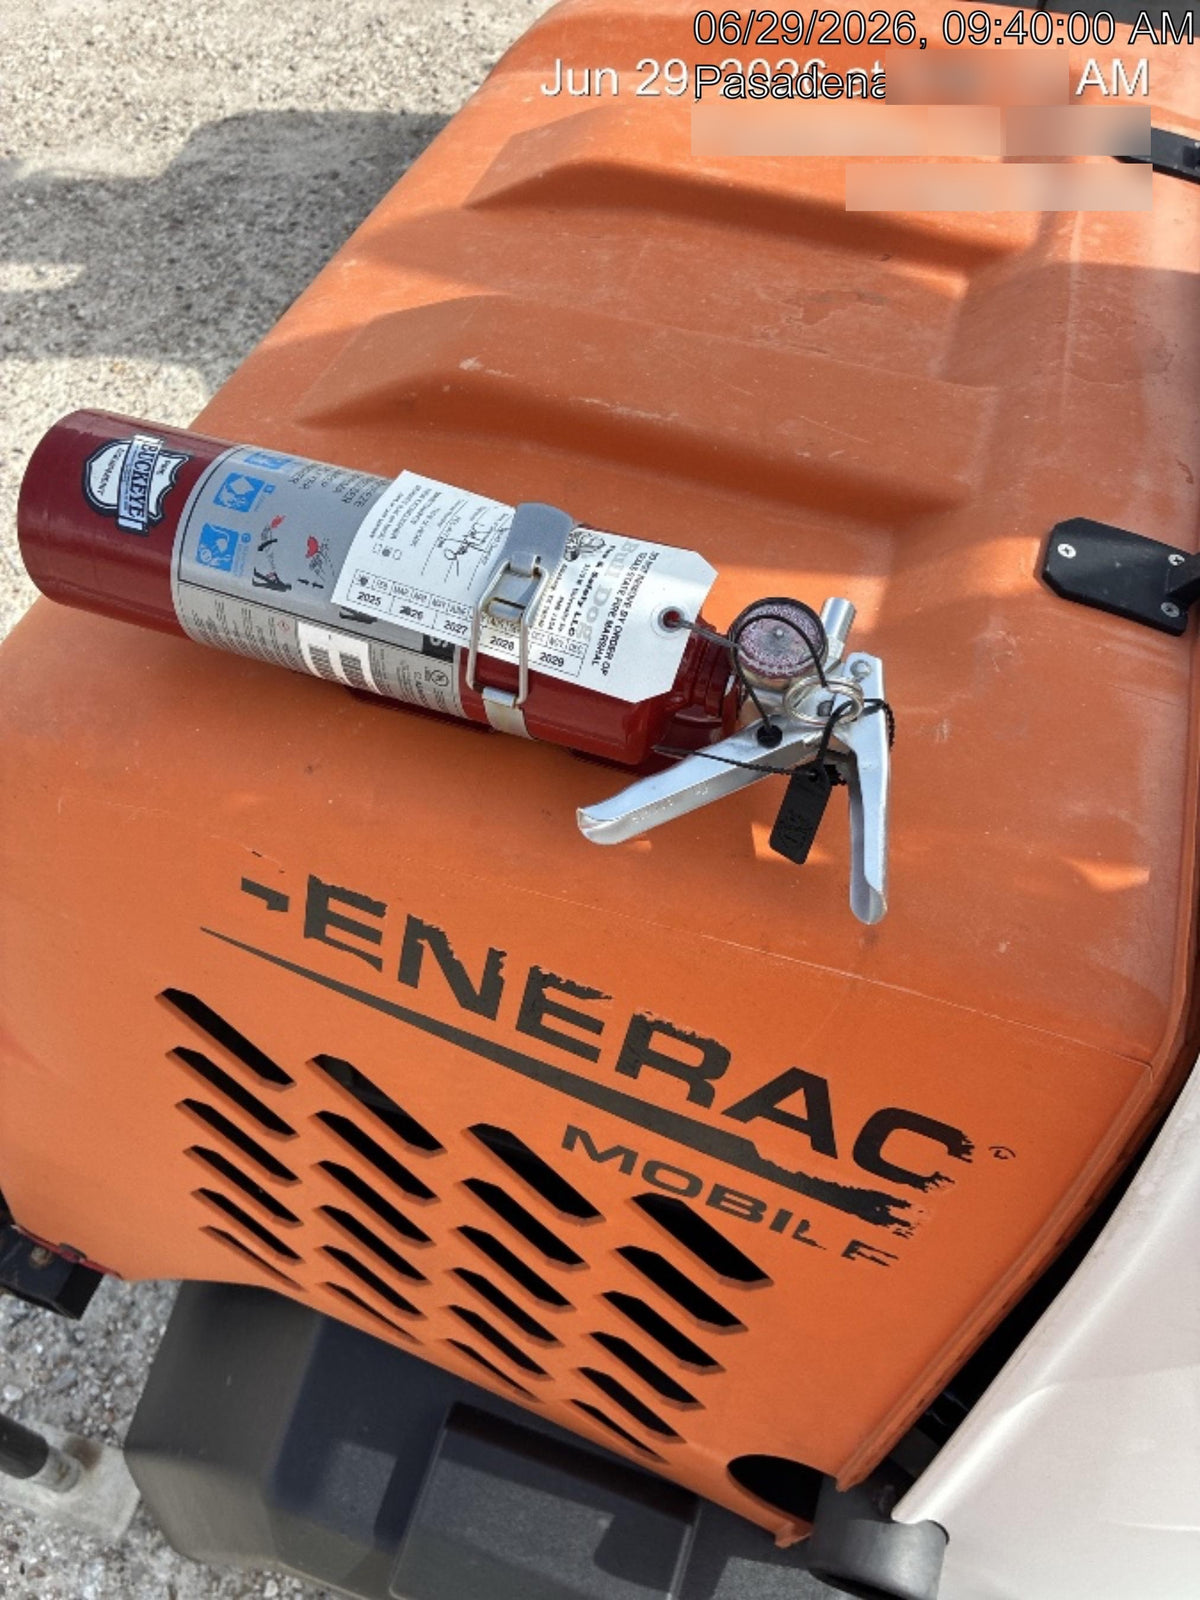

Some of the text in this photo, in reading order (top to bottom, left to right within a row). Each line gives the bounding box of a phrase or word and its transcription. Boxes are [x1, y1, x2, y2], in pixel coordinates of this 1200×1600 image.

[127, 443, 157, 518] BUCKEYE
[574, 540, 639, 644] Bull Dog
[577, 571, 599, 608] Safety
[356, 591, 565, 668] 2025 226 2027 2028 2029
[591, 619, 614, 667] MARSHAL
[604, 624, 624, 661] ORDER
[600, 661, 612, 676] OF
[241, 868, 974, 1193] ENERAC
